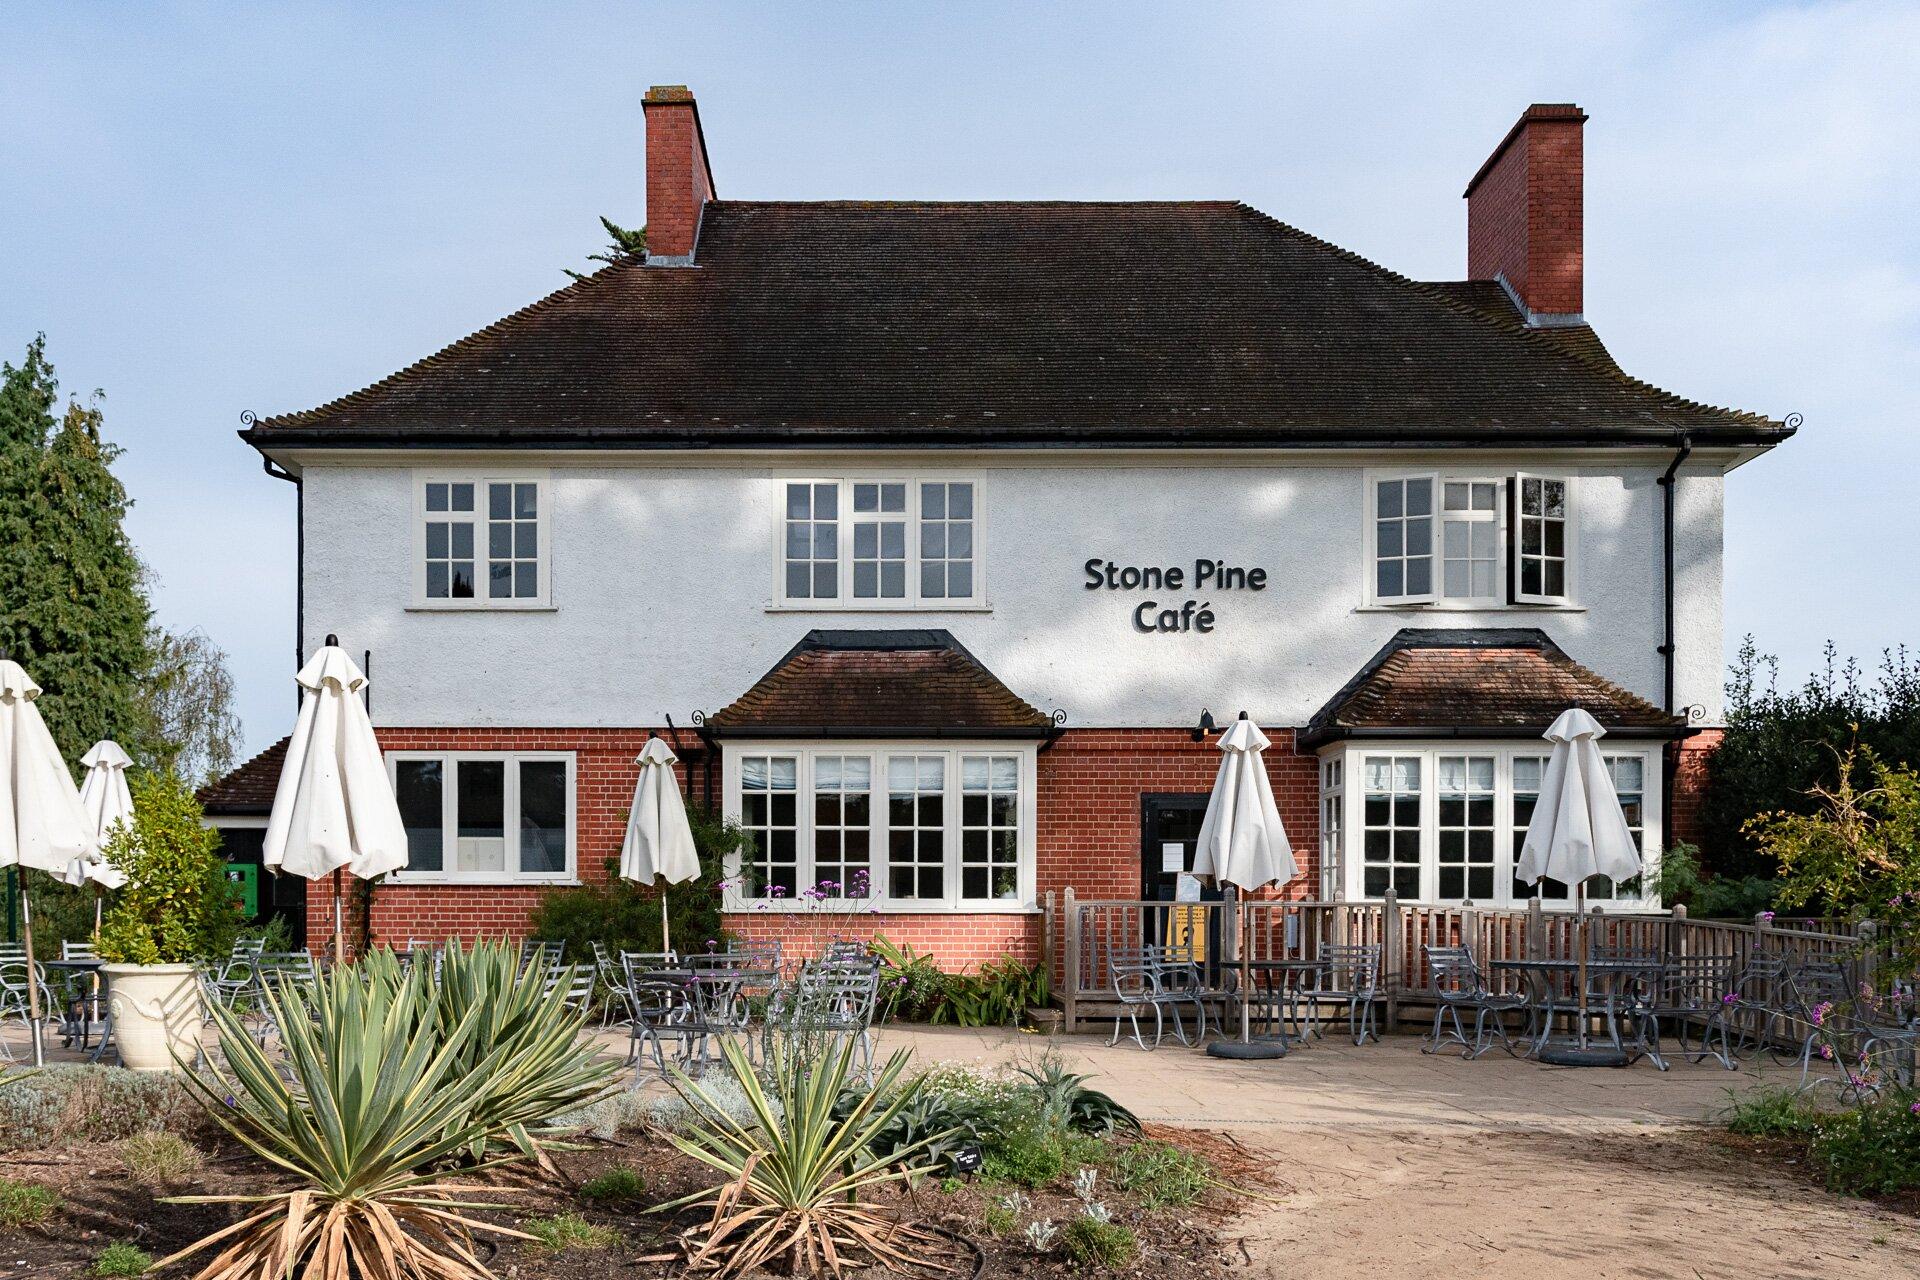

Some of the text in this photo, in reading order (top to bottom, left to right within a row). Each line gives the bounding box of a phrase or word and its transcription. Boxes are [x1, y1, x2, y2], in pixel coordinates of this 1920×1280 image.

[1084, 558, 1267, 592] Stone Pine
[1134, 600, 1216, 634] Café
